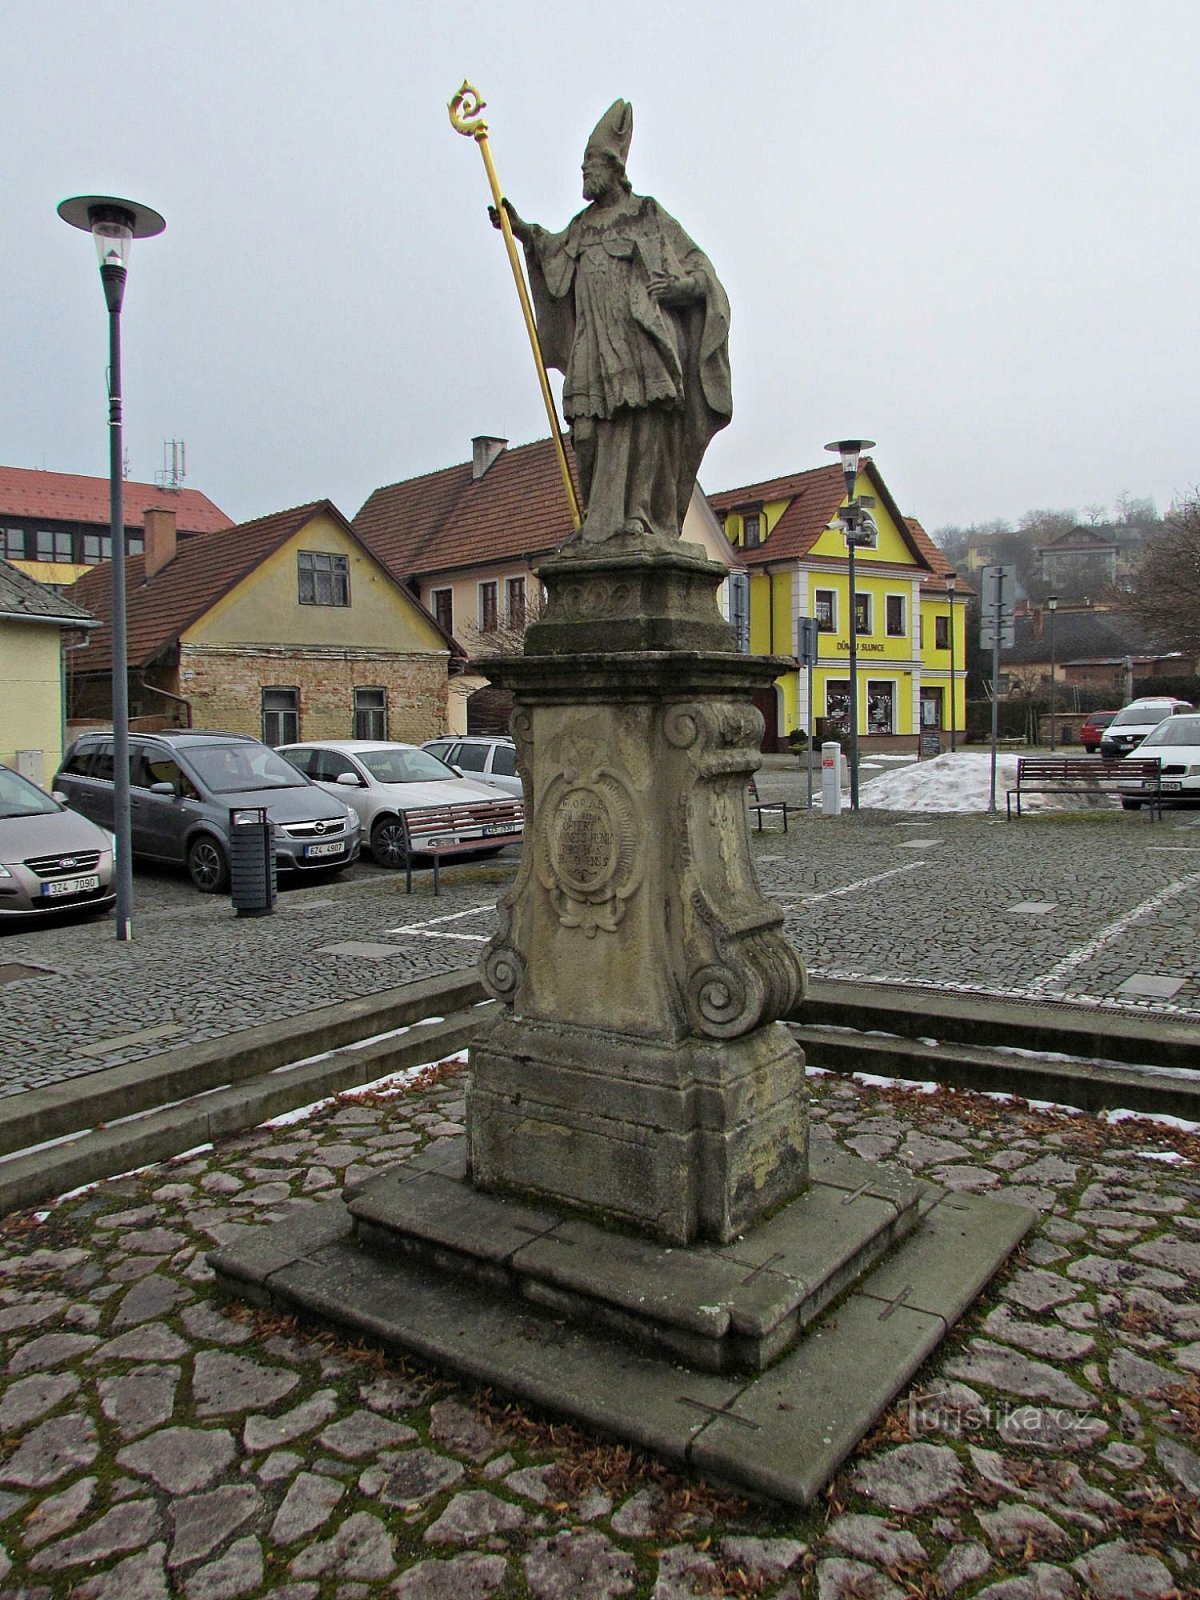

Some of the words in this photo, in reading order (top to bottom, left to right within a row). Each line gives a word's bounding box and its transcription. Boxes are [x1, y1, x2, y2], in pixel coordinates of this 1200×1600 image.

[861, 643, 884, 652] SLUNCE
[327, 843, 343, 852] 4907
[52, 882, 68, 894] 3Z4
[74, 878, 95, 890] 7090
